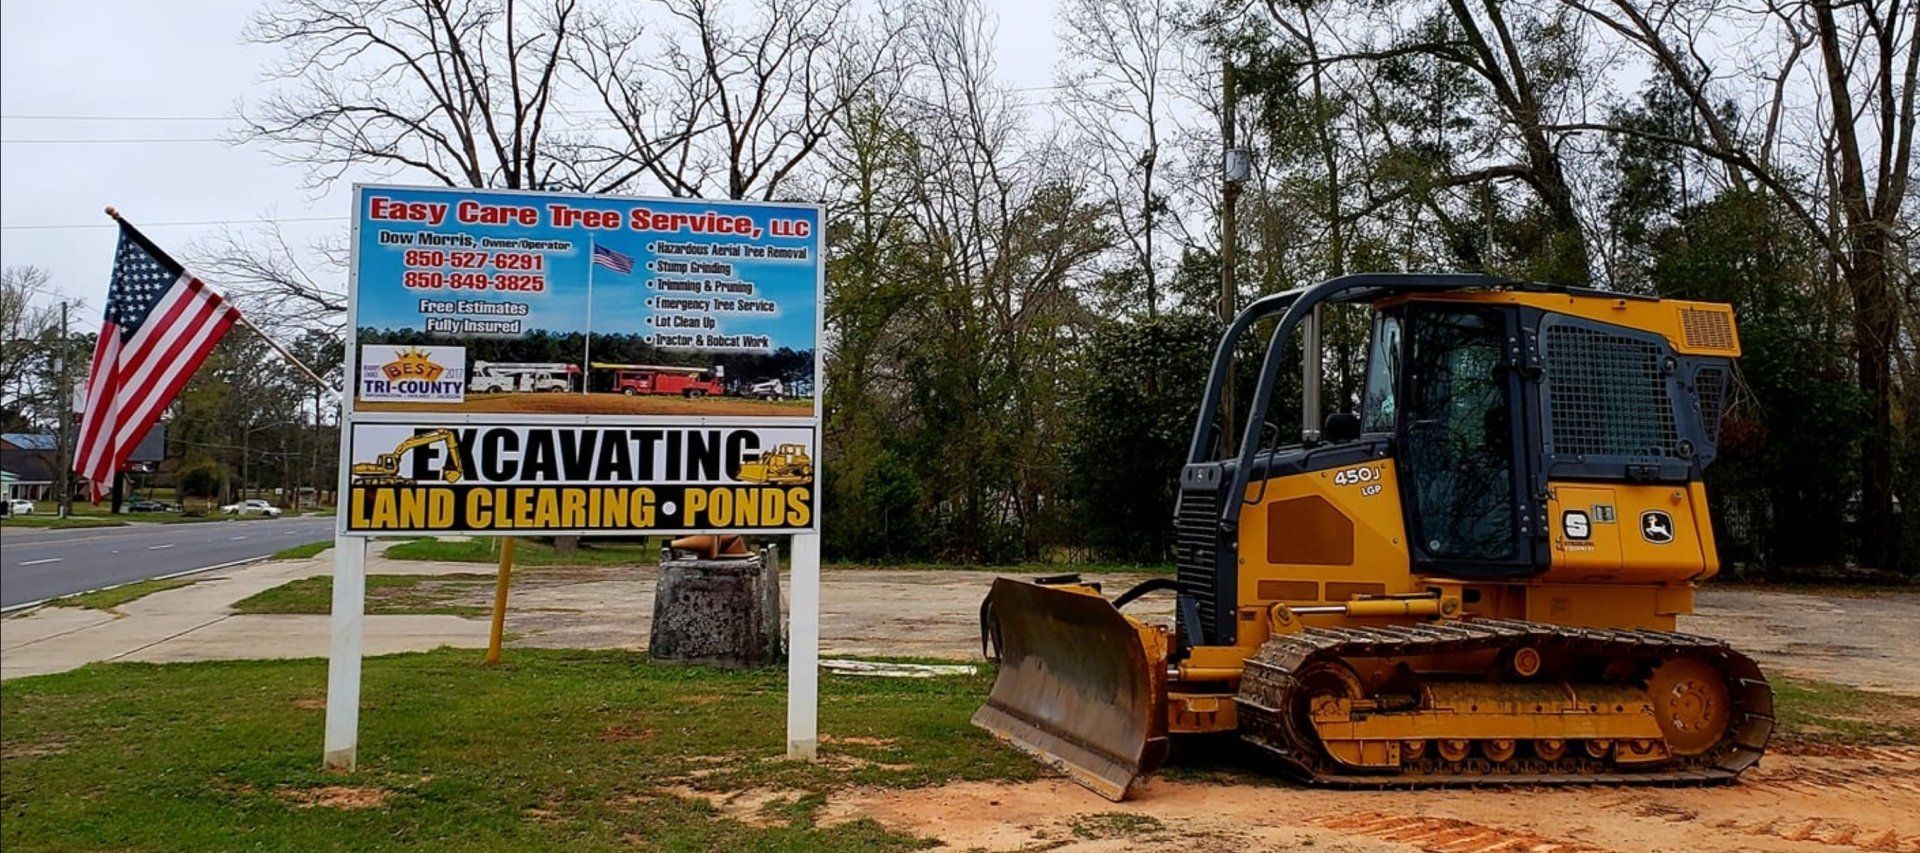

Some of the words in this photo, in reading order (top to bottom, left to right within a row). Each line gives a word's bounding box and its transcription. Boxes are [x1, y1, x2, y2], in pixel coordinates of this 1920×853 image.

[370, 198, 447, 224] Easy
[458, 201, 537, 224] Care
[549, 205, 620, 228] Tree
[631, 209, 761, 238] Service,
[772, 220, 809, 236] LLC
[380, 231, 413, 245] Dow
[418, 233, 476, 248] Morris,
[482, 239, 570, 250] Owner/Operator
[657, 242, 709, 256] Hazardous
[712, 244, 740, 257] Aerial
[743, 246, 765, 258] Tree
[767, 247, 807, 259] Removal
[405, 250, 543, 270] 850-527-6291
[657, 262, 687, 275] Stump
[691, 263, 731, 276] Grinding
[404, 272, 544, 292] 850-849-3825
[657, 281, 701, 293] Trimming
[704, 282, 712, 292] &
[715, 282, 752, 295] Pruning
[420, 300, 453, 314] Free
[458, 301, 527, 315] Estimates
[656, 299, 710, 312] Emergency
[714, 299, 735, 311] Tree
[738, 300, 774, 312] Service
[427, 319, 461, 334] Fully
[464, 320, 520, 333] Insured
[656, 317, 671, 327] Lot
[674, 317, 700, 328] Clean
[703, 318, 715, 329] Up
[655, 334, 693, 346] Tractor
[696, 336, 704, 346] &
[707, 335, 740, 347] Bobcat
[743, 337, 769, 348] Work
[387, 363, 438, 378] BEST
[363, 380, 463, 394] TRI-COUNTY
[413, 428, 760, 482] EXCAVATING
[1335, 467, 1380, 485] 450J
[1361, 485, 1382, 496] LGP
[351, 488, 455, 528] LAND
[466, 487, 655, 528] CLEARING
[684, 487, 810, 527] PONDS
